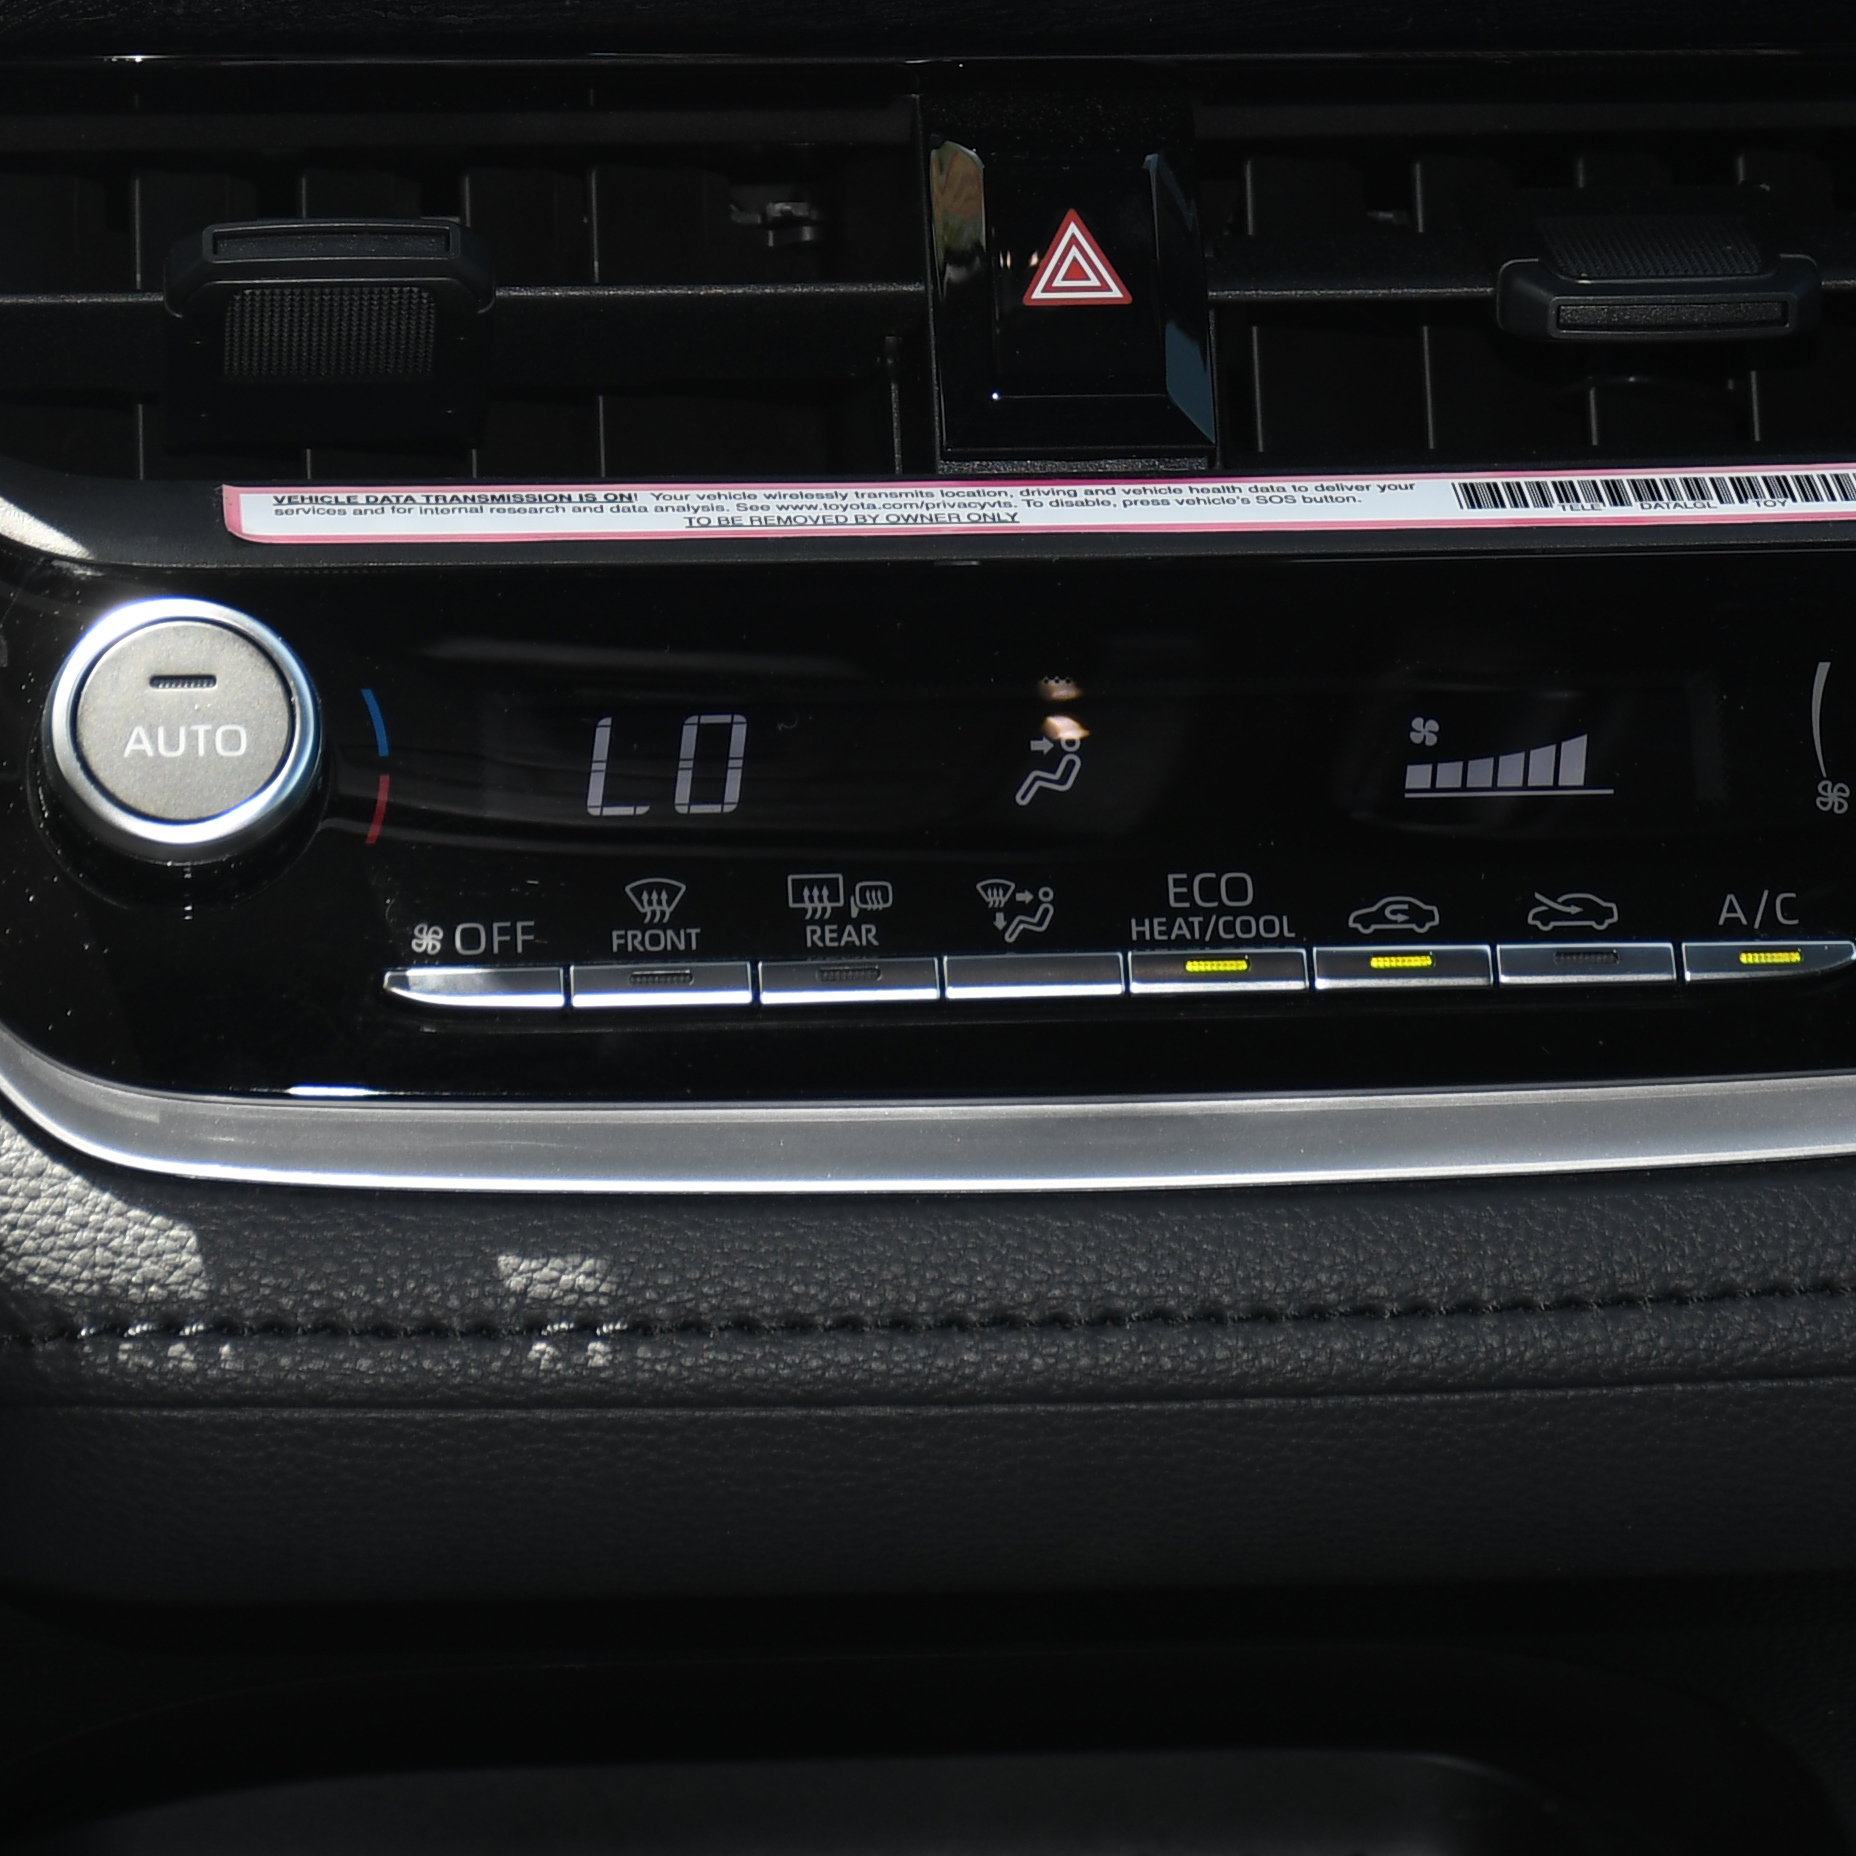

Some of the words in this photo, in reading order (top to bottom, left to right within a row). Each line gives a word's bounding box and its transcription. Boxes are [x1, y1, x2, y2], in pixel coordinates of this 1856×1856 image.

[272, 493, 359, 505] VEHICLE
[365, 493, 415, 505] DATA
[421, 492, 572, 504] TRANSMISSION
[578, 492, 596, 503] IS
[603, 492, 638, 503] ON!
[650, 491, 691, 501] Your
[696, 491, 757, 500] vehicle
[763, 490, 849, 501] wirelessly
[854, 489, 935, 499] transmits
[941, 488, 1014, 499] location,
[1019, 487, 1078, 499] driving
[1083, 486, 1116, 496] and
[1121, 486, 1182, 495] vehicle
[1188, 484, 1242, 494] health
[1247, 483, 1286, 494] data
[1291, 483, 1309, 493] to
[1314, 482, 1371, 493] deliver
[1376, 482, 1415, 493] your
[274, 505, 347, 516] services
[352, 505, 385, 515] and
[391, 505, 413, 515] for
[419, 504, 484, 514] internal
[489, 504, 565, 514] research
[571, 503, 604, 514] and
[609, 503, 648, 513] data
[654, 502, 730, 514] analysis.
[736, 502, 770, 512] See
[1021, 499, 1043, 509] To
[1048, 497, 1117, 509] disable,
[1122, 497, 1171, 509] press
[1175, 495, 1251, 506] vehicle's
[1255, 494, 1297, 505] SOS
[1302, 493, 1362, 504] button.
[683, 515, 712, 528] TO
[718, 515, 743, 527] BE
[749, 514, 849, 527] REMOVED
[853, 513, 880, 526] BY
[885, 512, 961, 525] OWNER
[967, 511, 1020, 524] ONLY
[123, 723, 247, 758] AUTO
[586, 714, 748, 817] LO
[1166, 872, 1254, 909] ECO
[1716, 890, 1800, 928] A/C
[454, 920, 536, 956] OFF
[611, 927, 702, 953] FRONT
[805, 923, 880, 948] REAR
[1130, 913, 1297, 942] HEAT/COOL
